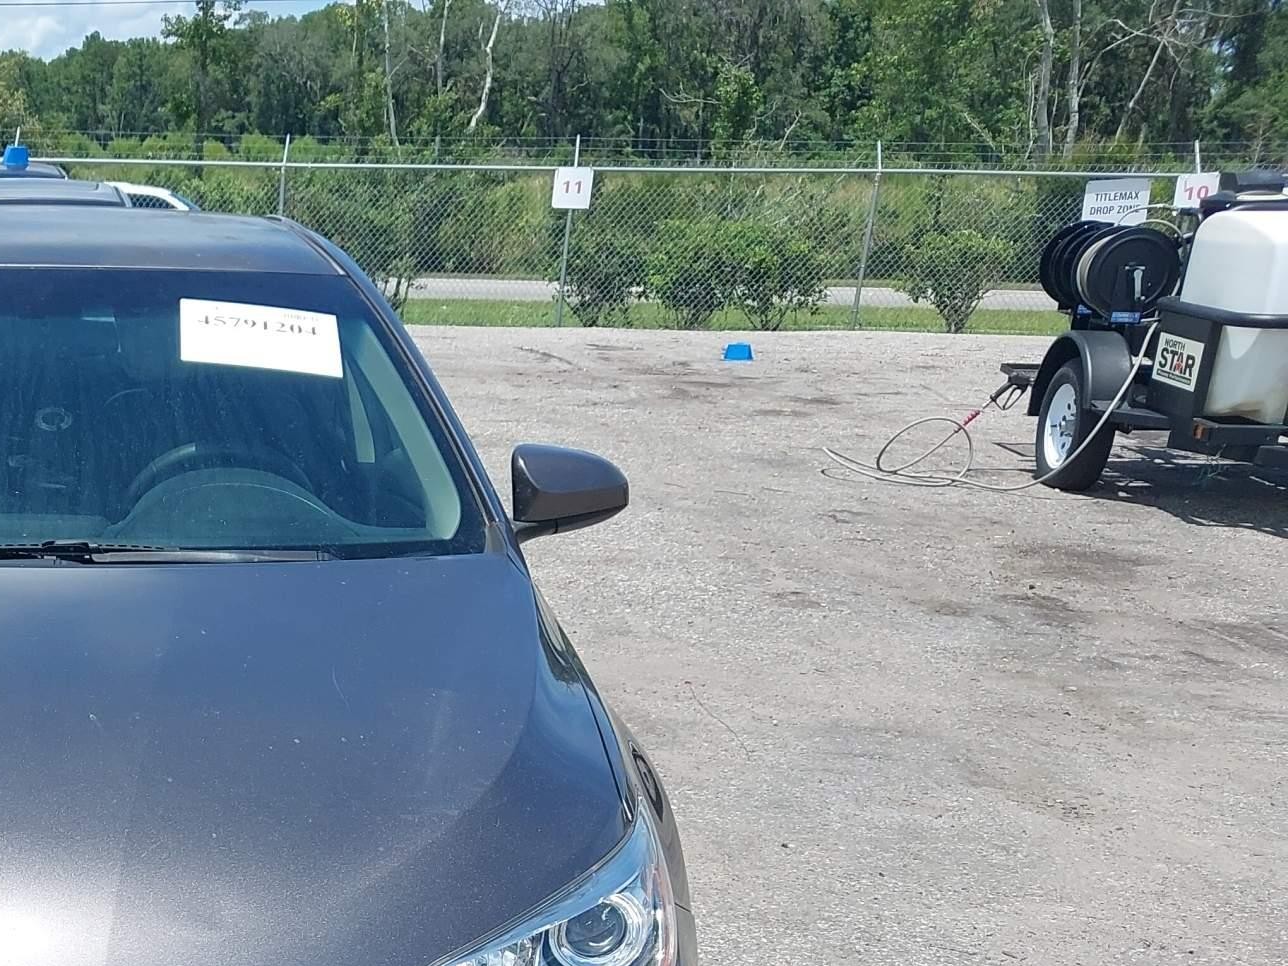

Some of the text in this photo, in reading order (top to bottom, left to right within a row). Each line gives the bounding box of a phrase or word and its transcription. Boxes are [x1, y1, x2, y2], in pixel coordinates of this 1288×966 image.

[562, 180, 582, 194] 11
[1183, 185, 1209, 201] 10
[1094, 191, 1140, 202] TITLEMAX
[1089, 205, 1114, 216] DROP
[197, 314, 319, 336] 45791204
[1164, 337, 1186, 352] NORTH
[1158, 346, 1196, 378] STAR
